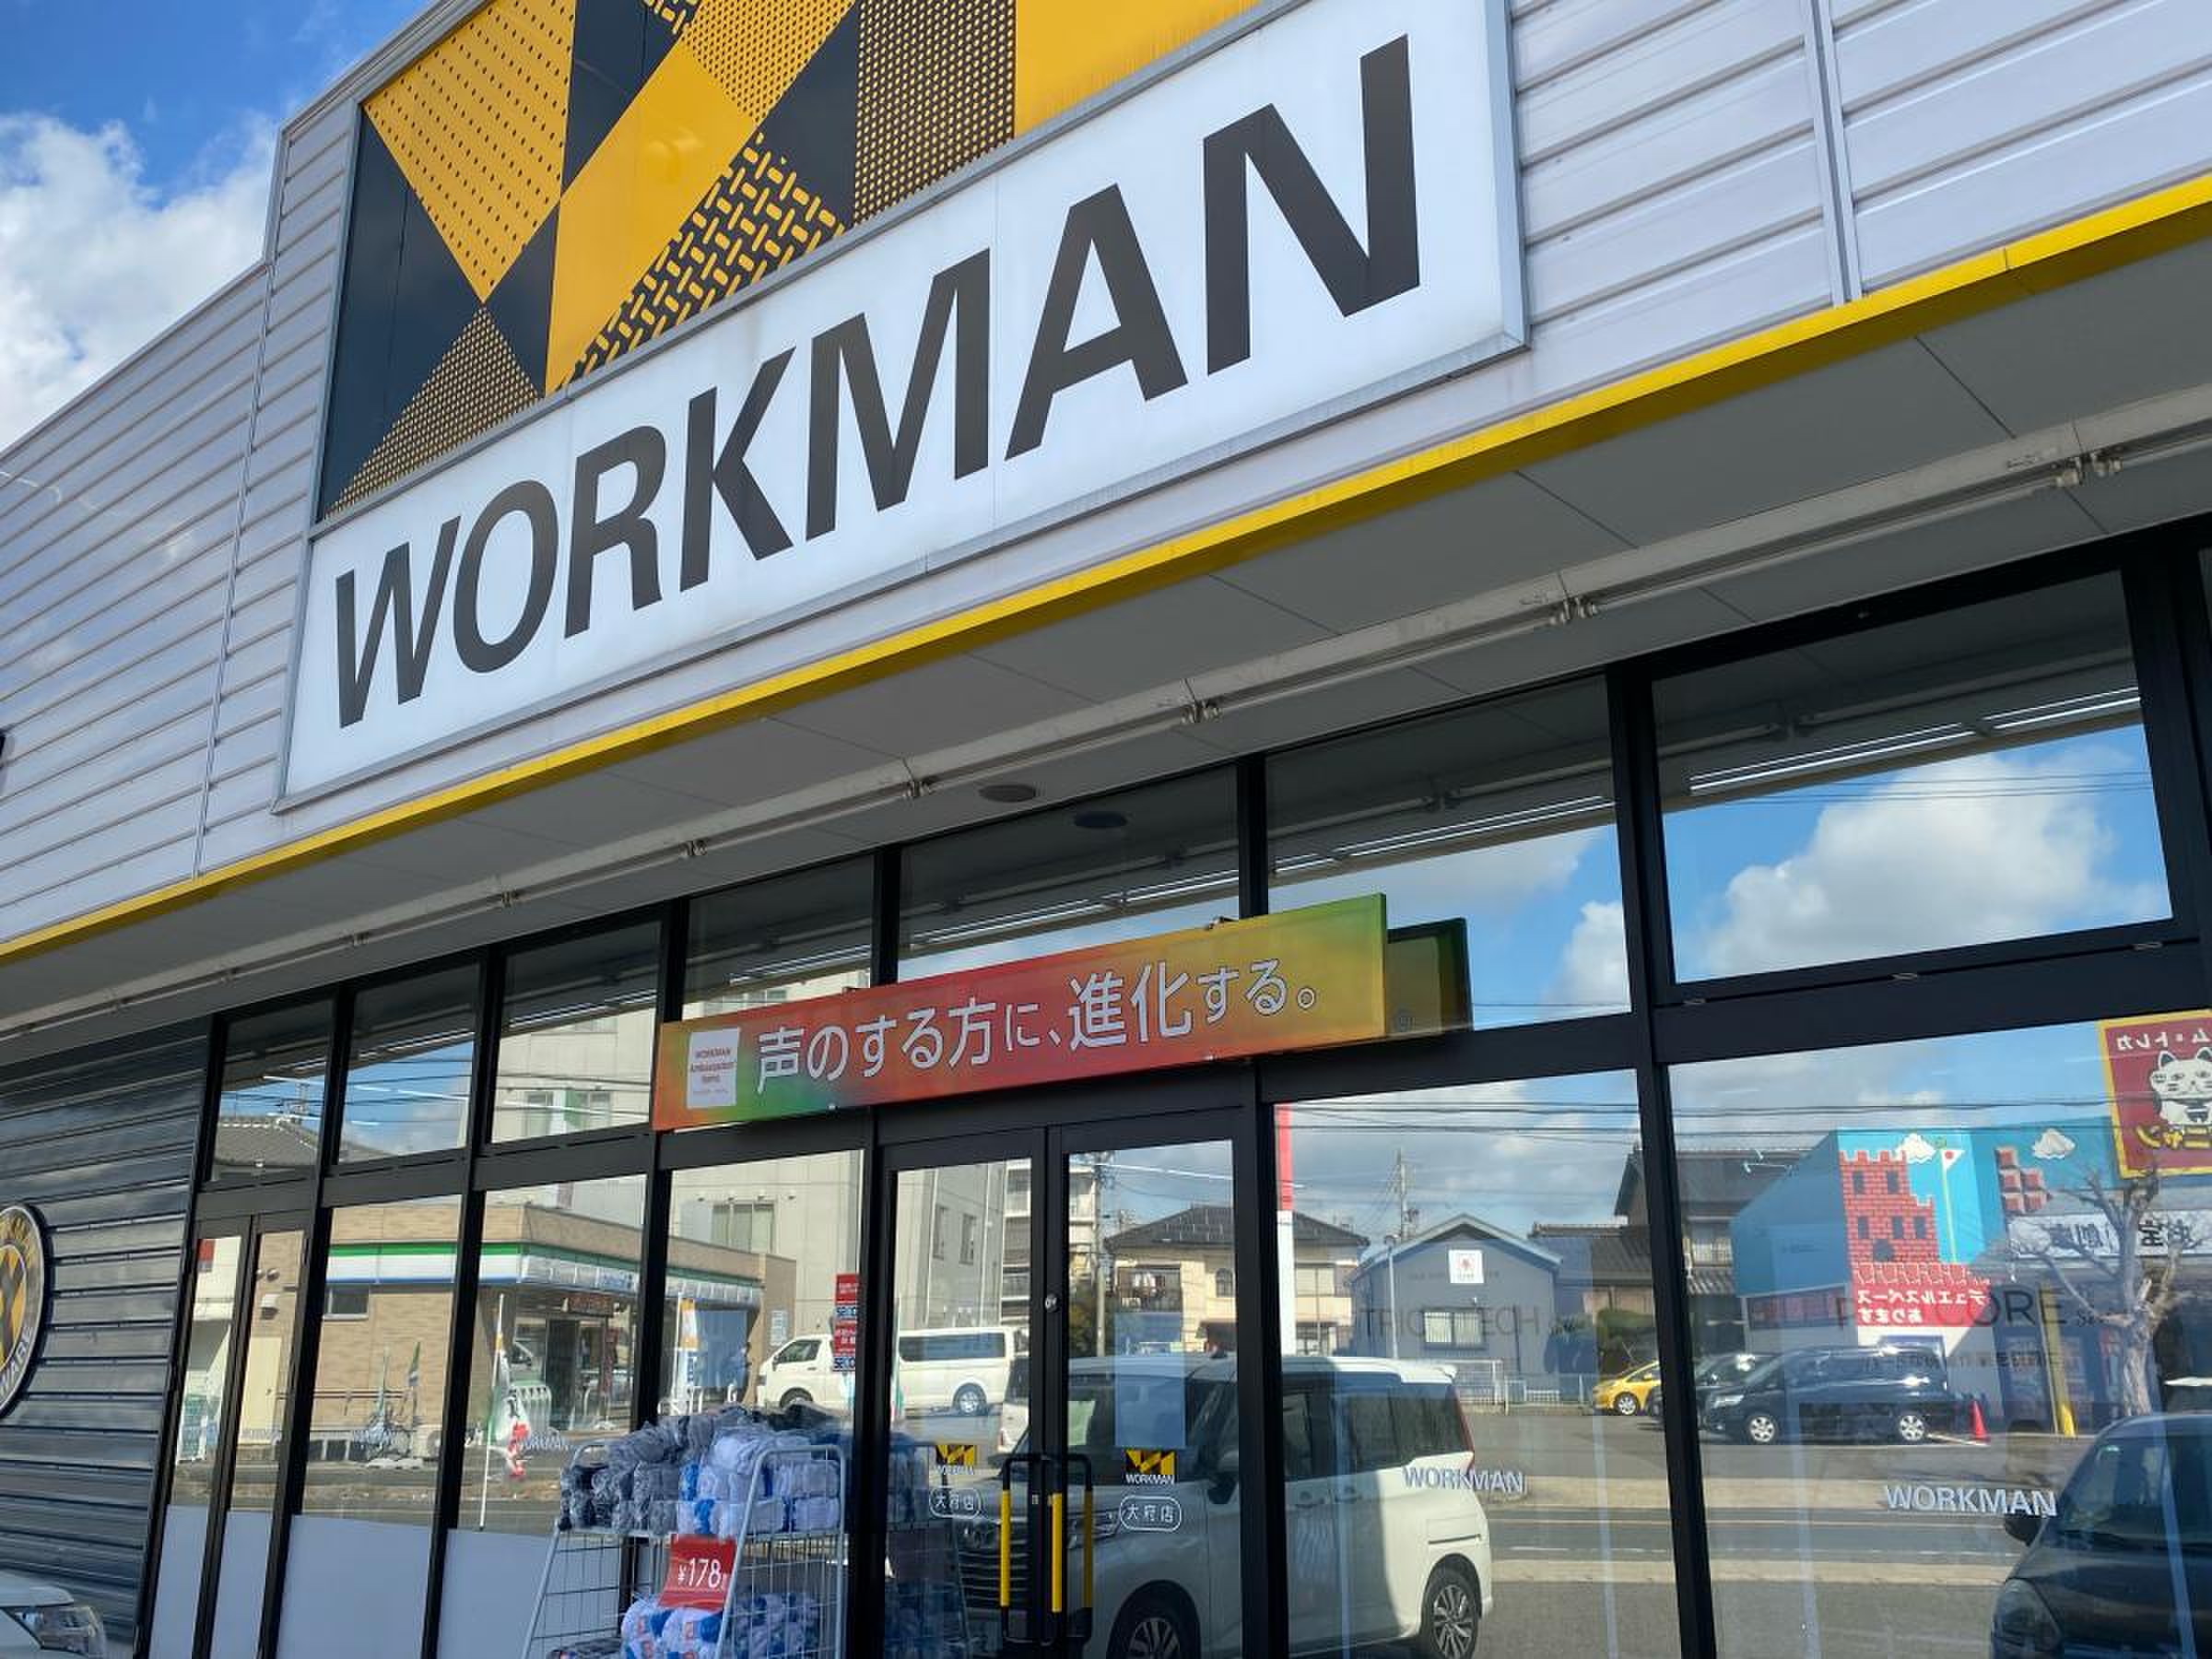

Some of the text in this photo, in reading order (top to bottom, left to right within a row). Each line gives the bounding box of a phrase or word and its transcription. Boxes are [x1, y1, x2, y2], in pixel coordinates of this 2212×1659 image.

[336, 34, 1419, 730] WORKMAN
[757, 958, 1316, 1095] 声のする方に、進化する。
[1125, 1474, 1175, 1485] WORKMAN
[1402, 1465, 1528, 1495] WORKMAN
[1885, 1484, 2057, 1517] WORKMAN
